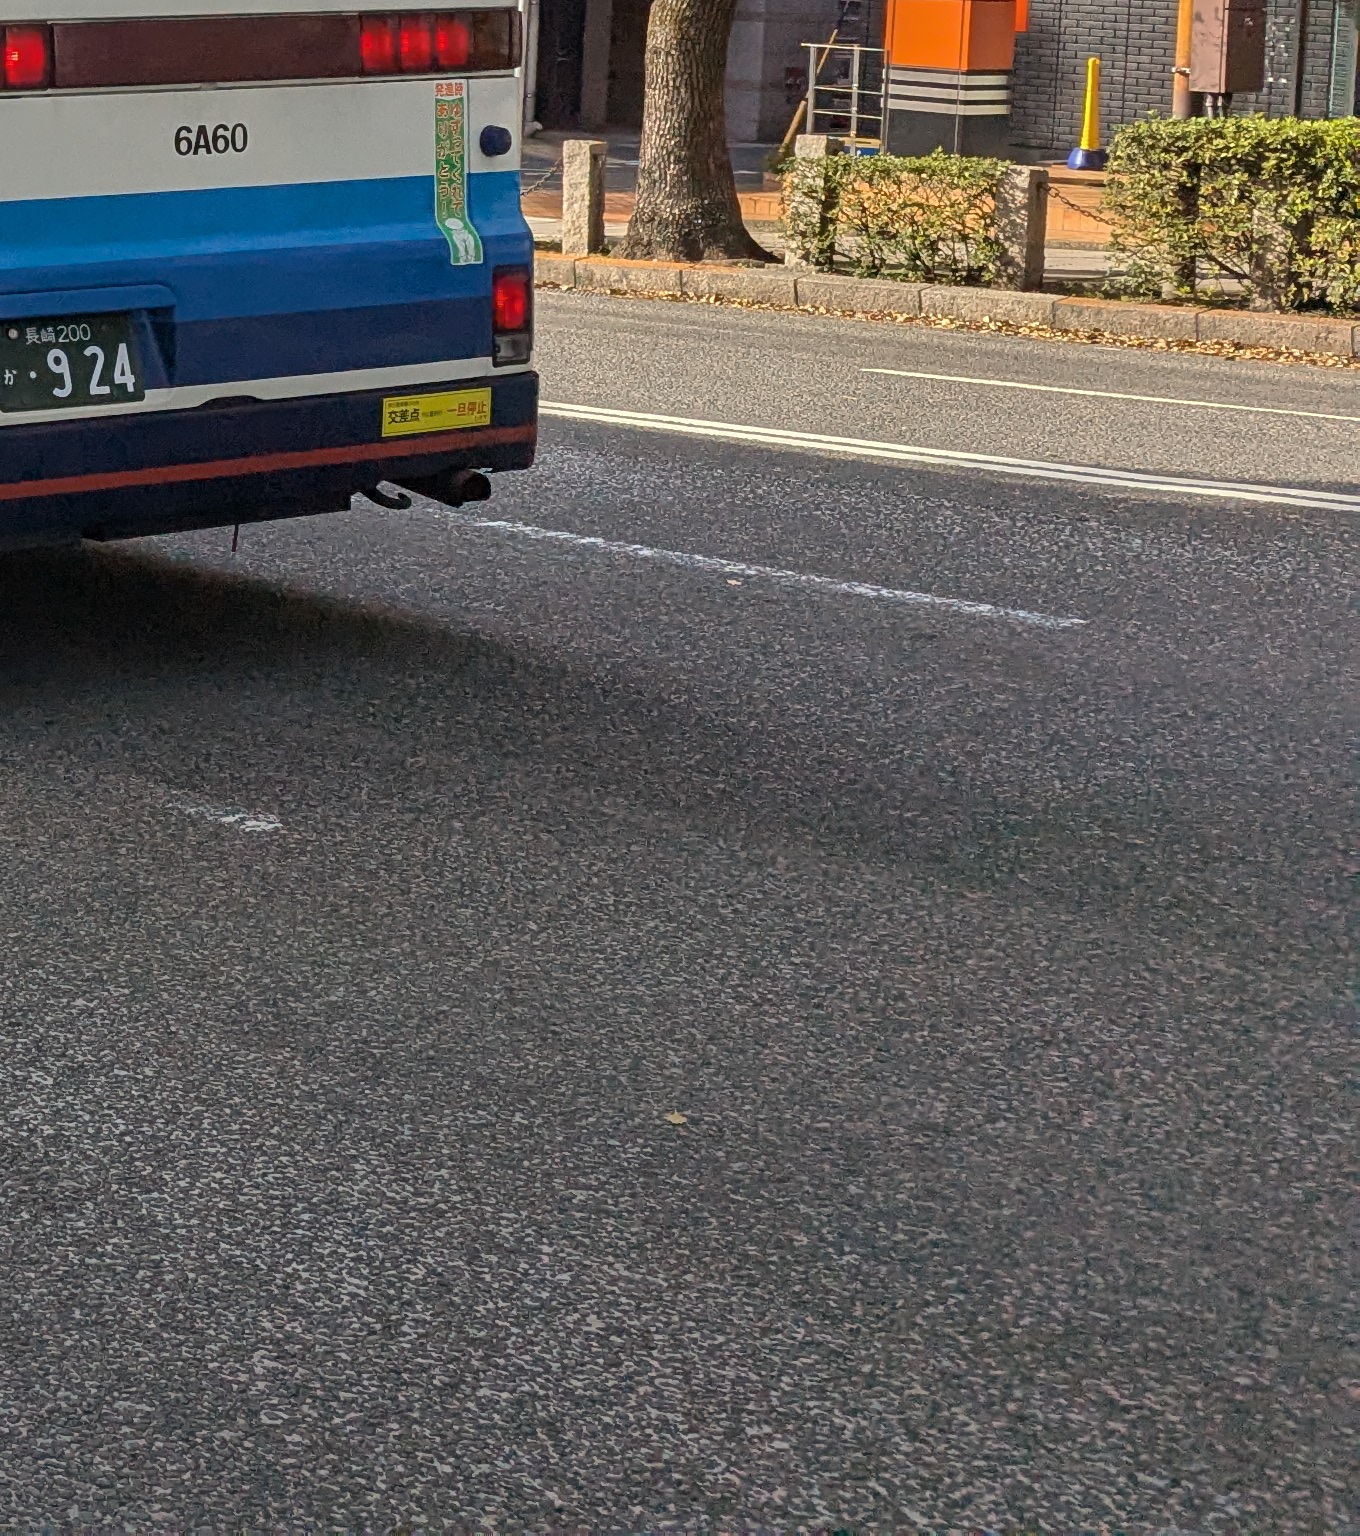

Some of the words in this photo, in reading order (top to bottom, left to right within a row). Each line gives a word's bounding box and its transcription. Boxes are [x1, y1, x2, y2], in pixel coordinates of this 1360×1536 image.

[174, 122, 248, 156] 6A60
[388, 407, 420, 424] 交差点
[447, 401, 487, 417] 一旦停止
